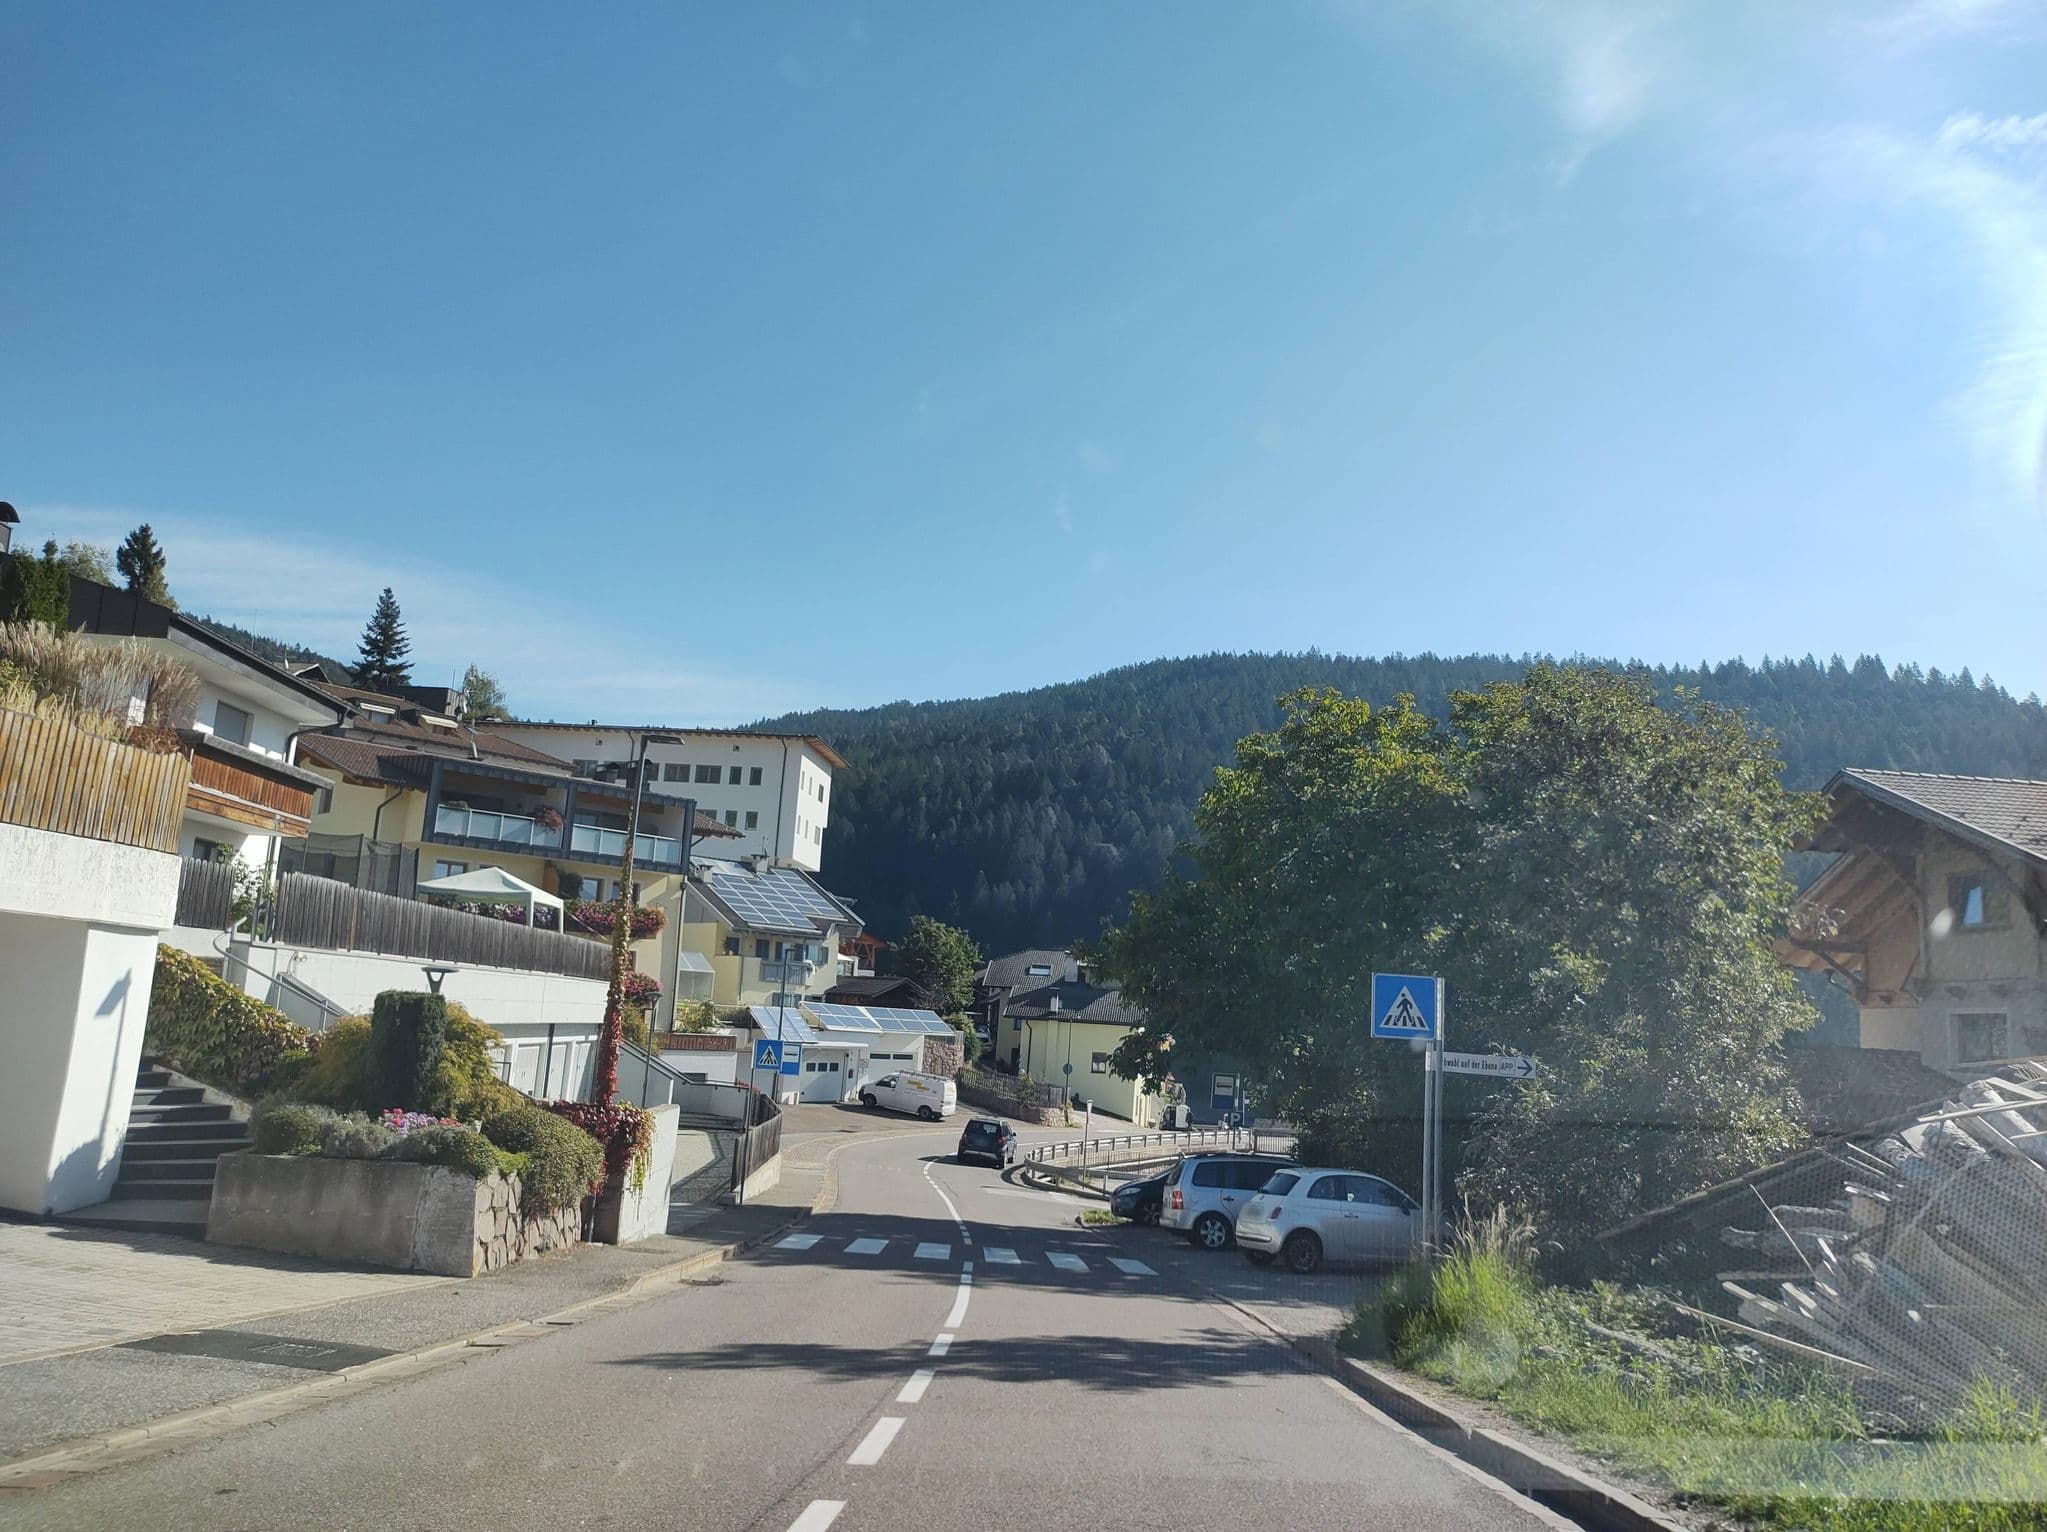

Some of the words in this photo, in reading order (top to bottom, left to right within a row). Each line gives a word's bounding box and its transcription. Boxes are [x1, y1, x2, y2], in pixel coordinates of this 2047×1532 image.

[1461, 1058, 1470, 1068] auf
[1471, 1060, 1480, 1070] der
[1481, 1060, 1497, 1071] Ebene
